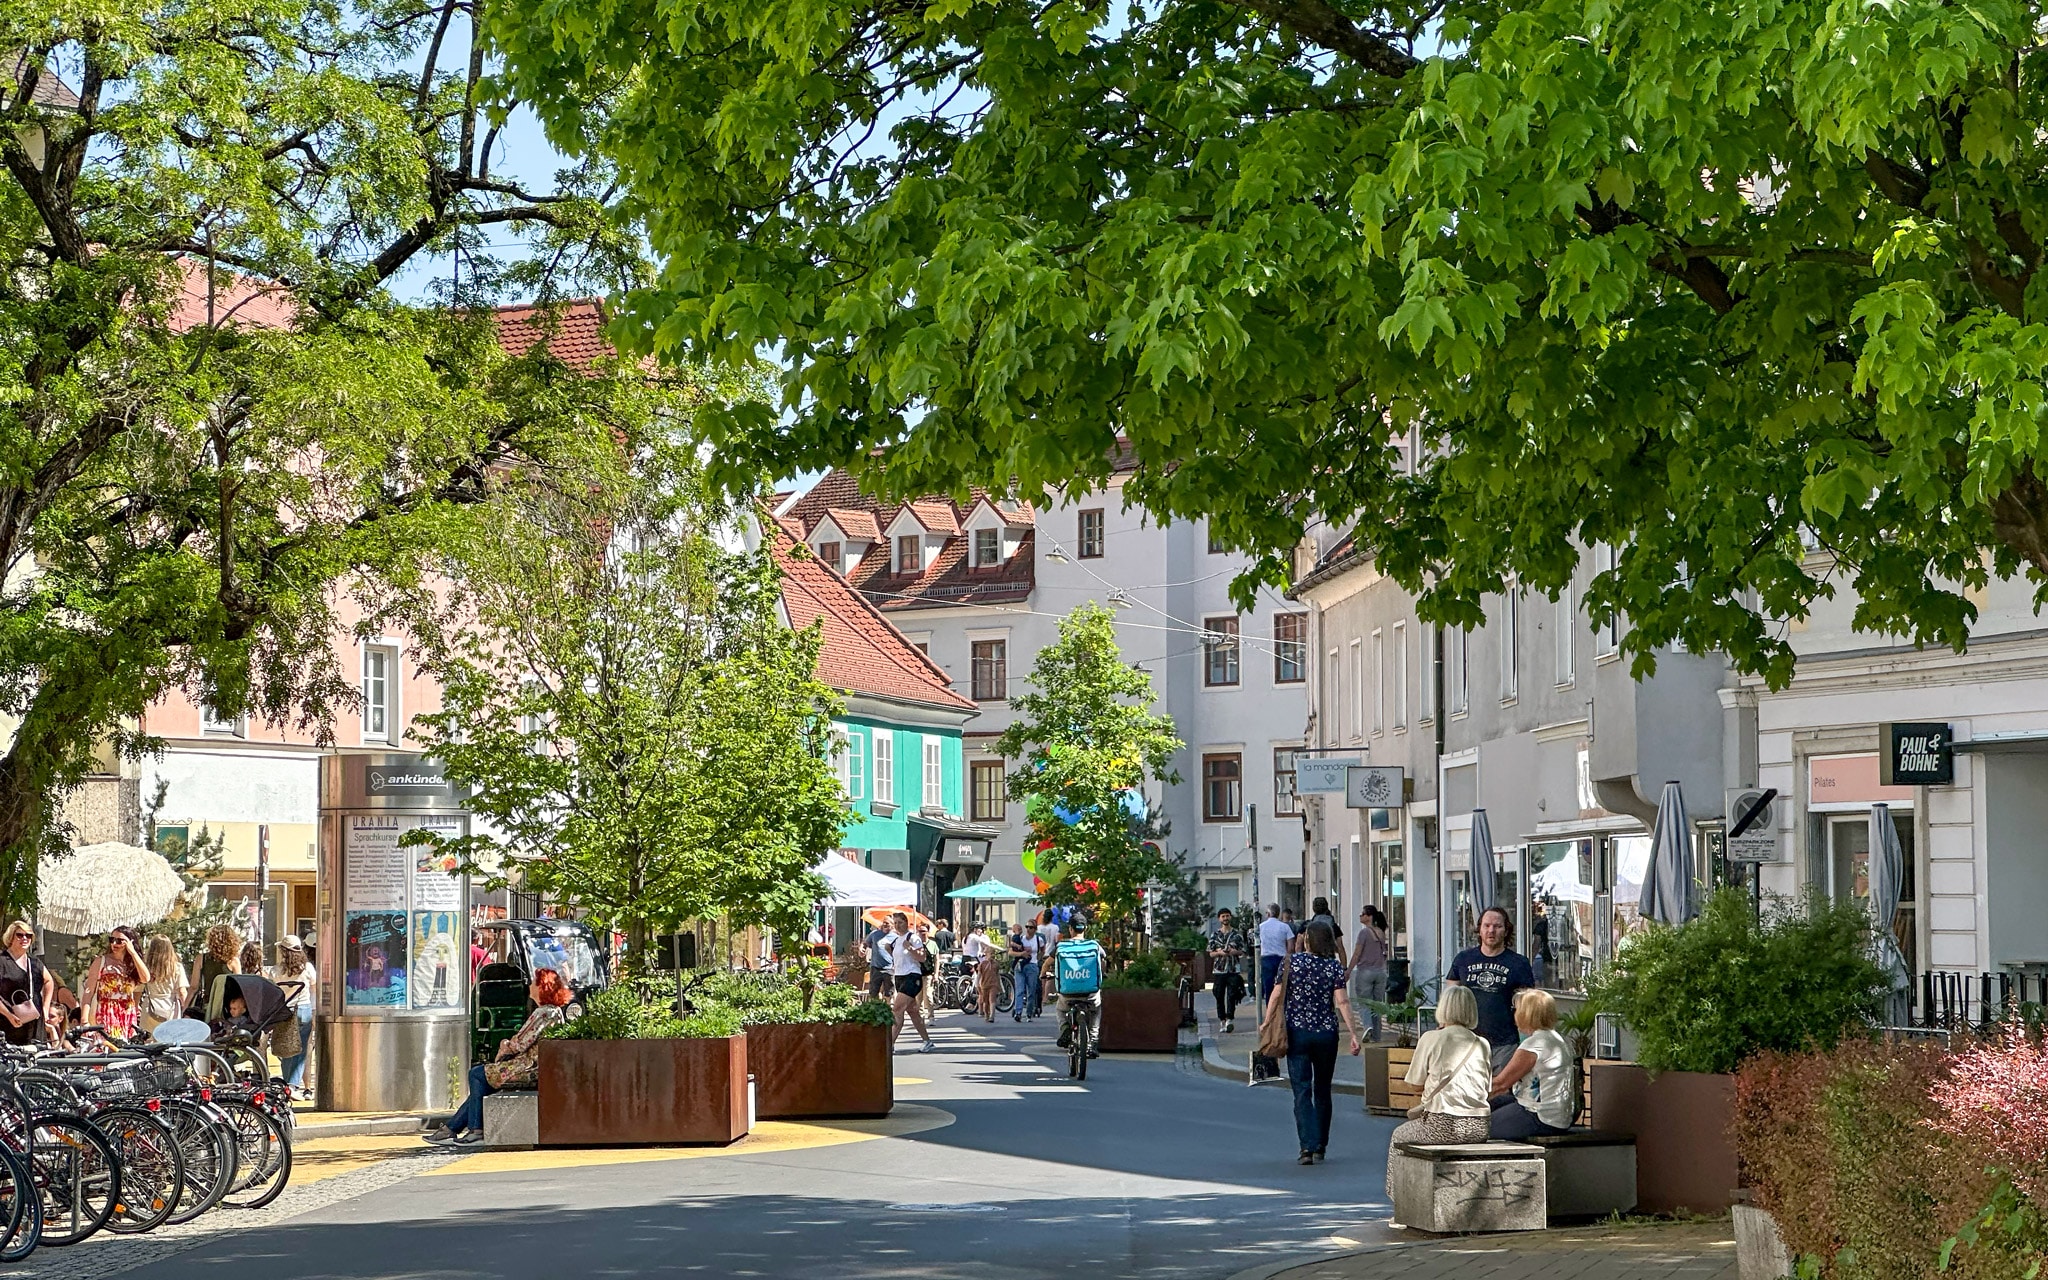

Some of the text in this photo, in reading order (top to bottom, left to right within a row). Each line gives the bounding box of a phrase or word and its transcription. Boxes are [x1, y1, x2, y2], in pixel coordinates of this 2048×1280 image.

[1899, 733, 1941, 754] PAUL &
[1899, 754, 1940, 772] BOHNE
[1814, 777, 1836, 787] Pilates
[352, 816, 399, 827] URANIA
[354, 833, 398, 842] Sprachkurse
[1065, 969, 1091, 980] Wolt
[1467, 963, 1510, 975] TOM TAILOR
